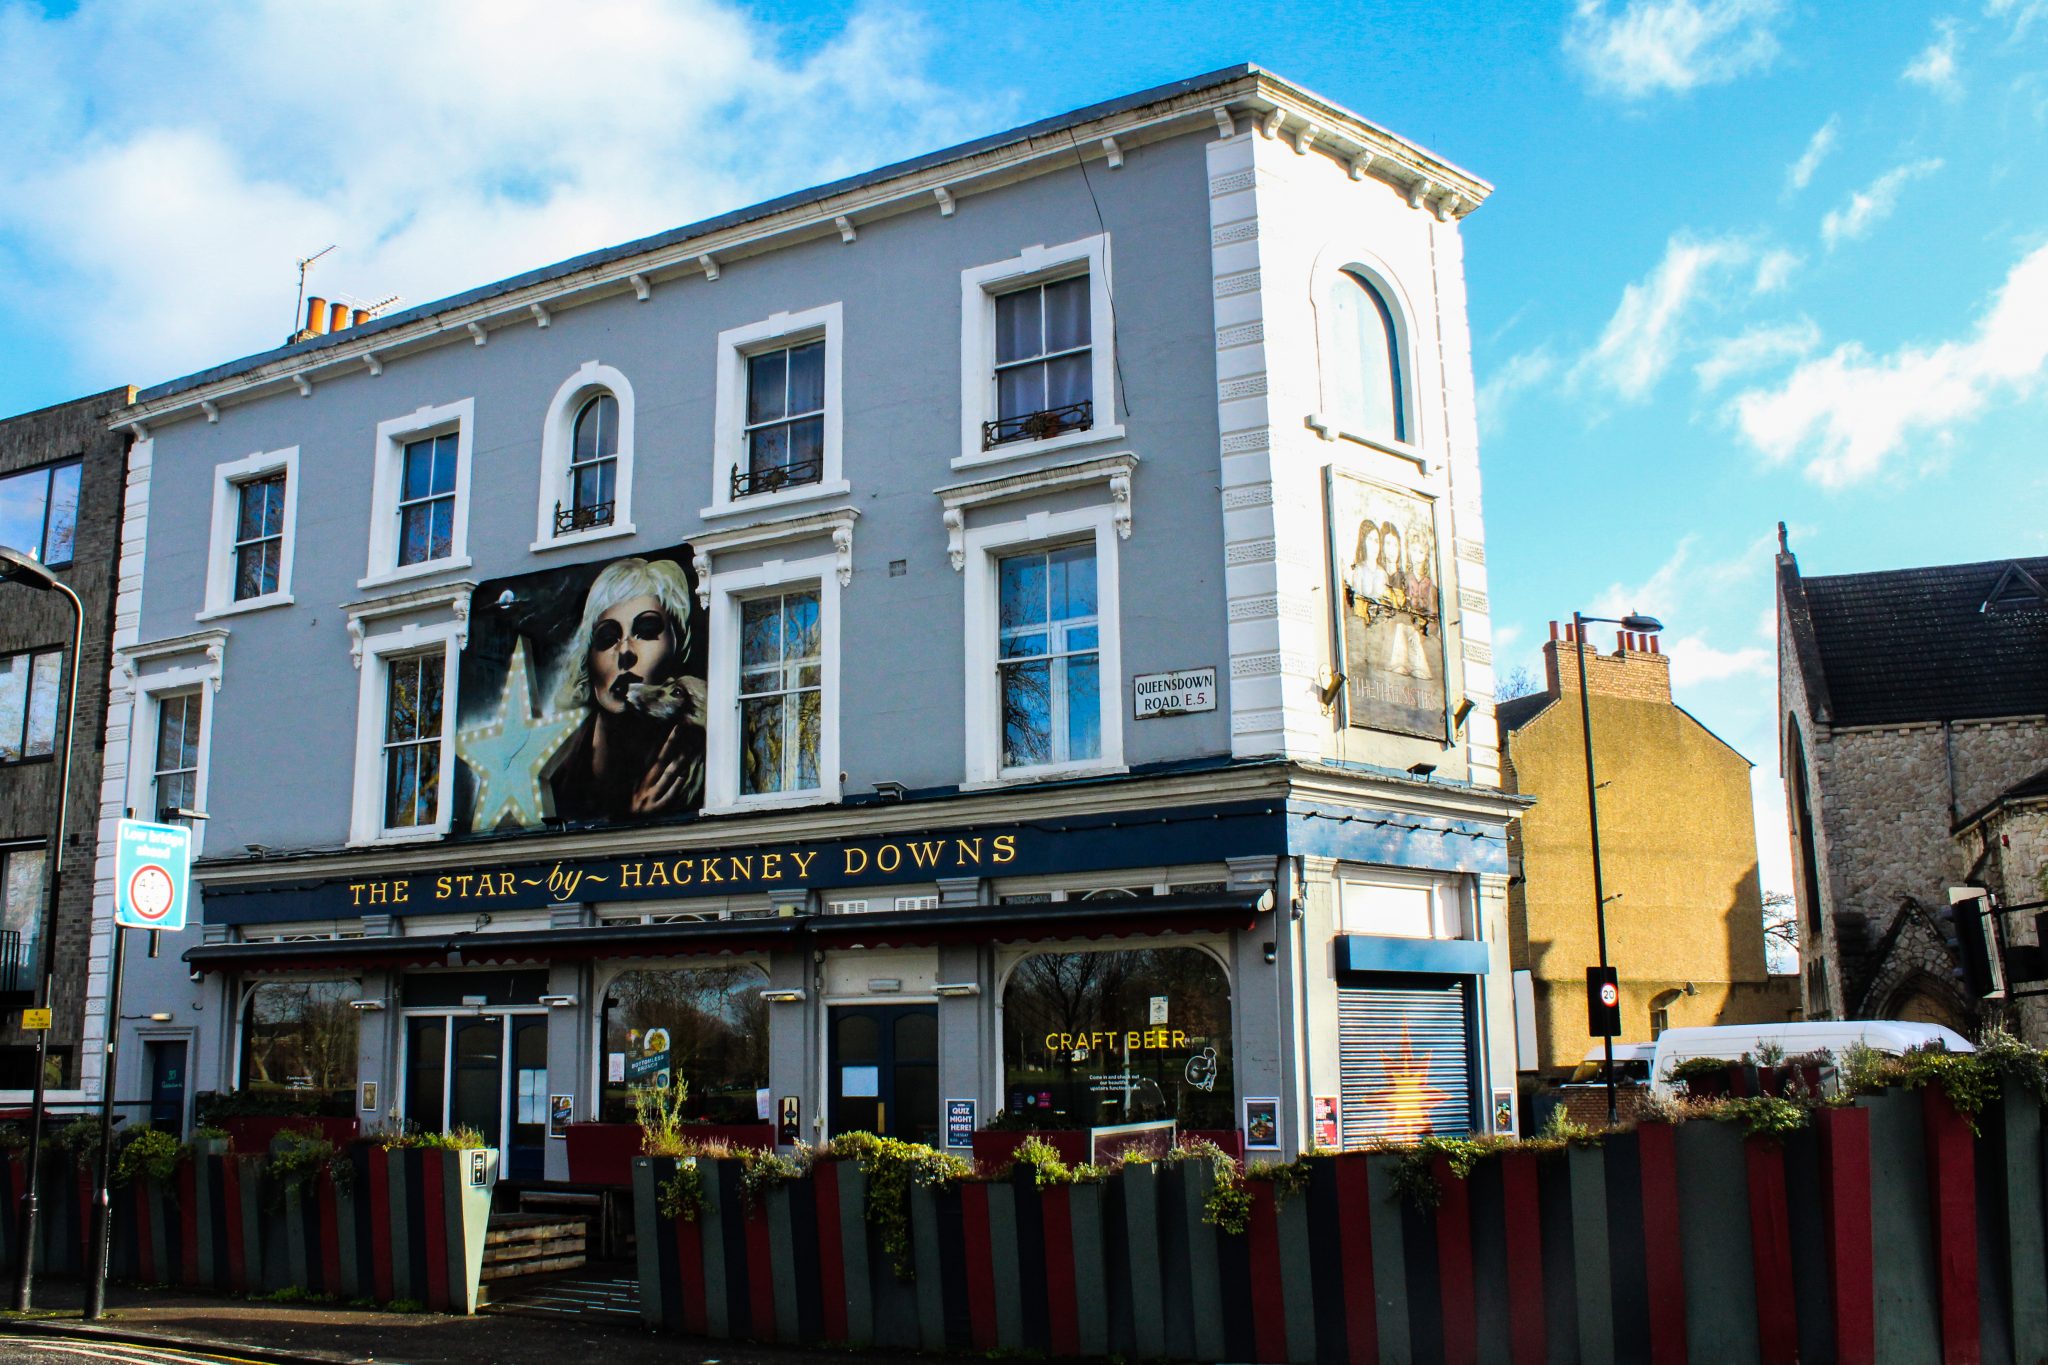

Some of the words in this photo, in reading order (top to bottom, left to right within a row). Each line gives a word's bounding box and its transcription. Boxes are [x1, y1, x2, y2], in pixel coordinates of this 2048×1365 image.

[1137, 675, 1212, 695] QUEENSDOWN
[123, 826, 148, 842] Low
[149, 830, 185, 848] bridge
[136, 844, 171, 860] ahead
[350, 880, 409, 906] THE
[436, 872, 517, 899] STAR
[546, 861, 583, 901] by
[620, 851, 818, 888] HACKNEY
[844, 835, 1016, 875] DOWNS
[1603, 989, 1615, 1000] 20
[1045, 1031, 1118, 1051] CRAFT
[1127, 1030, 1186, 1049] BEER
[950, 1115, 973, 1123] NIGHT
[952, 1107, 970, 1115] QUIZ
[950, 1123, 972, 1131] HERE!
